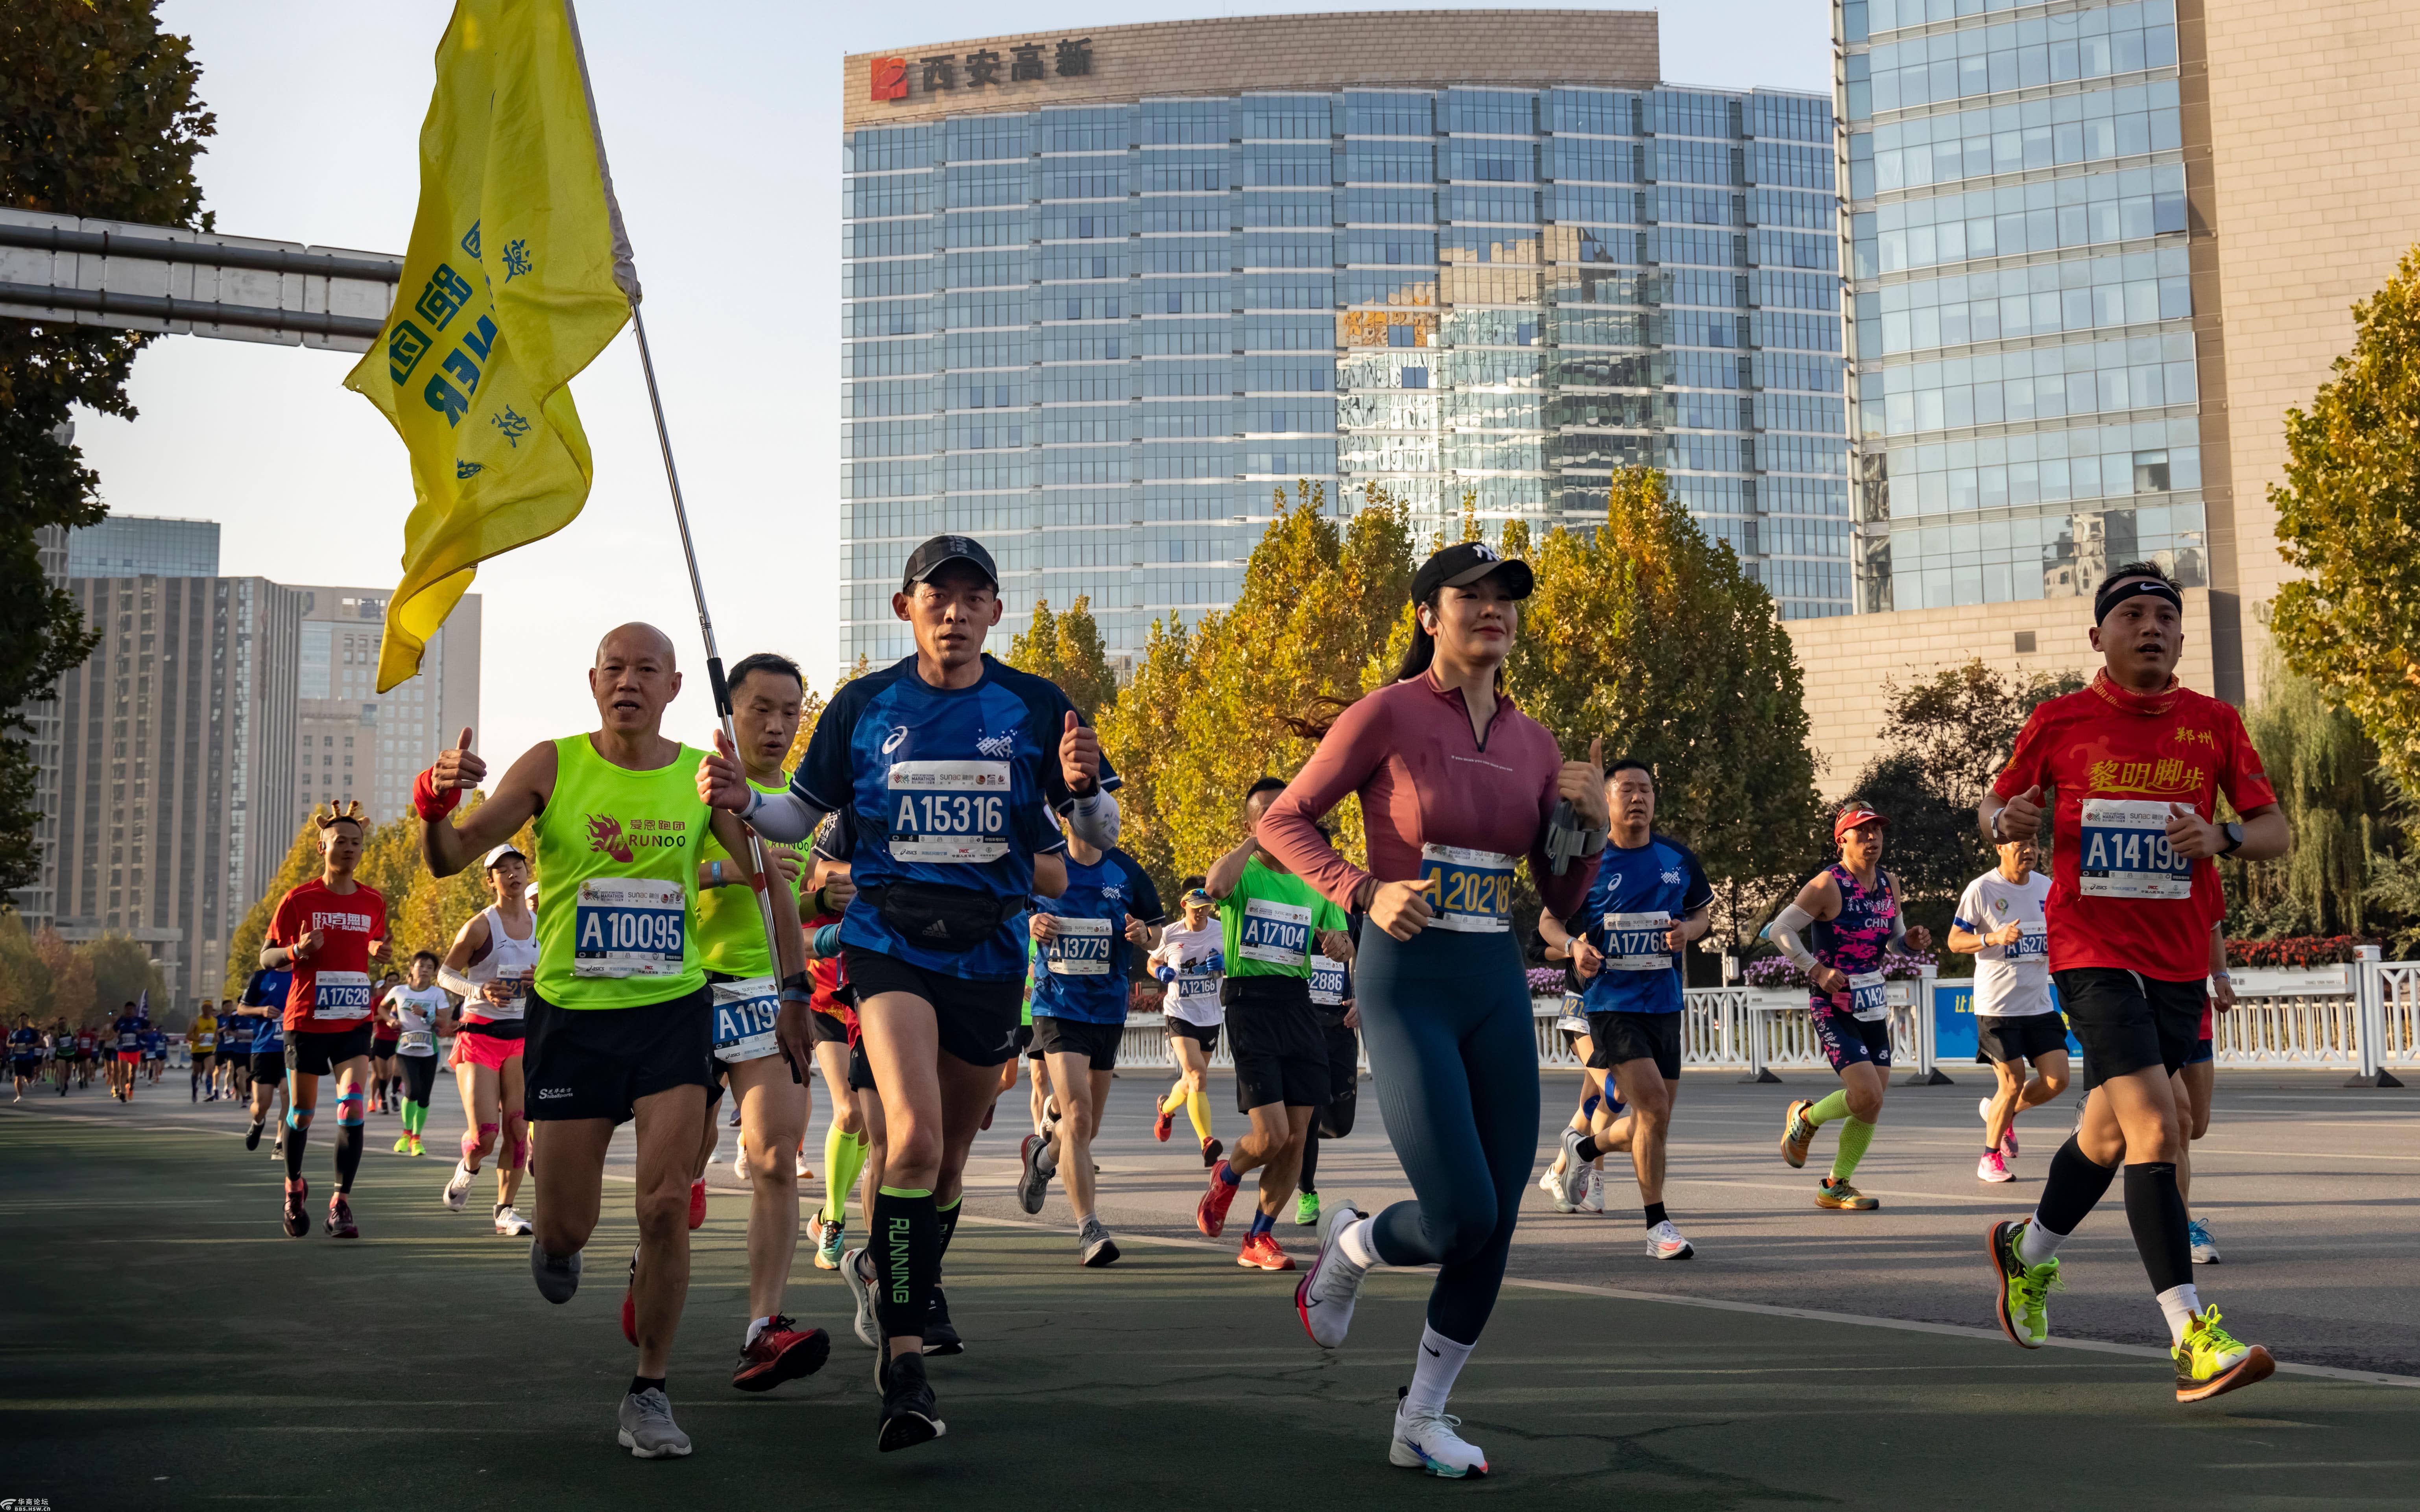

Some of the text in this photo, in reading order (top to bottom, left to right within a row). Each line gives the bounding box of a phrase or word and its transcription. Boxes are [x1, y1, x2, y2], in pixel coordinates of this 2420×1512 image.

[920, 37, 1093, 92] 西安高新
[2174, 726, 2215, 750] 郑州
[2088, 758, 2204, 791] 黎明脚步
[630, 819, 685, 831] 爱恩跑团
[896, 795, 1002, 832] A15316
[1421, 867, 1511, 914] A20218
[581, 912, 681, 951] A10095
[1245, 919, 1305, 949] A17104
[1864, 918, 1889, 928] CHN
[1049, 935, 1109, 958] A13779
[1608, 931, 1669, 953] A17768
[317, 988, 369, 1005] A17628
[1181, 979, 1215, 994] A12166
[889, 1217, 910, 1303] RUNNING
